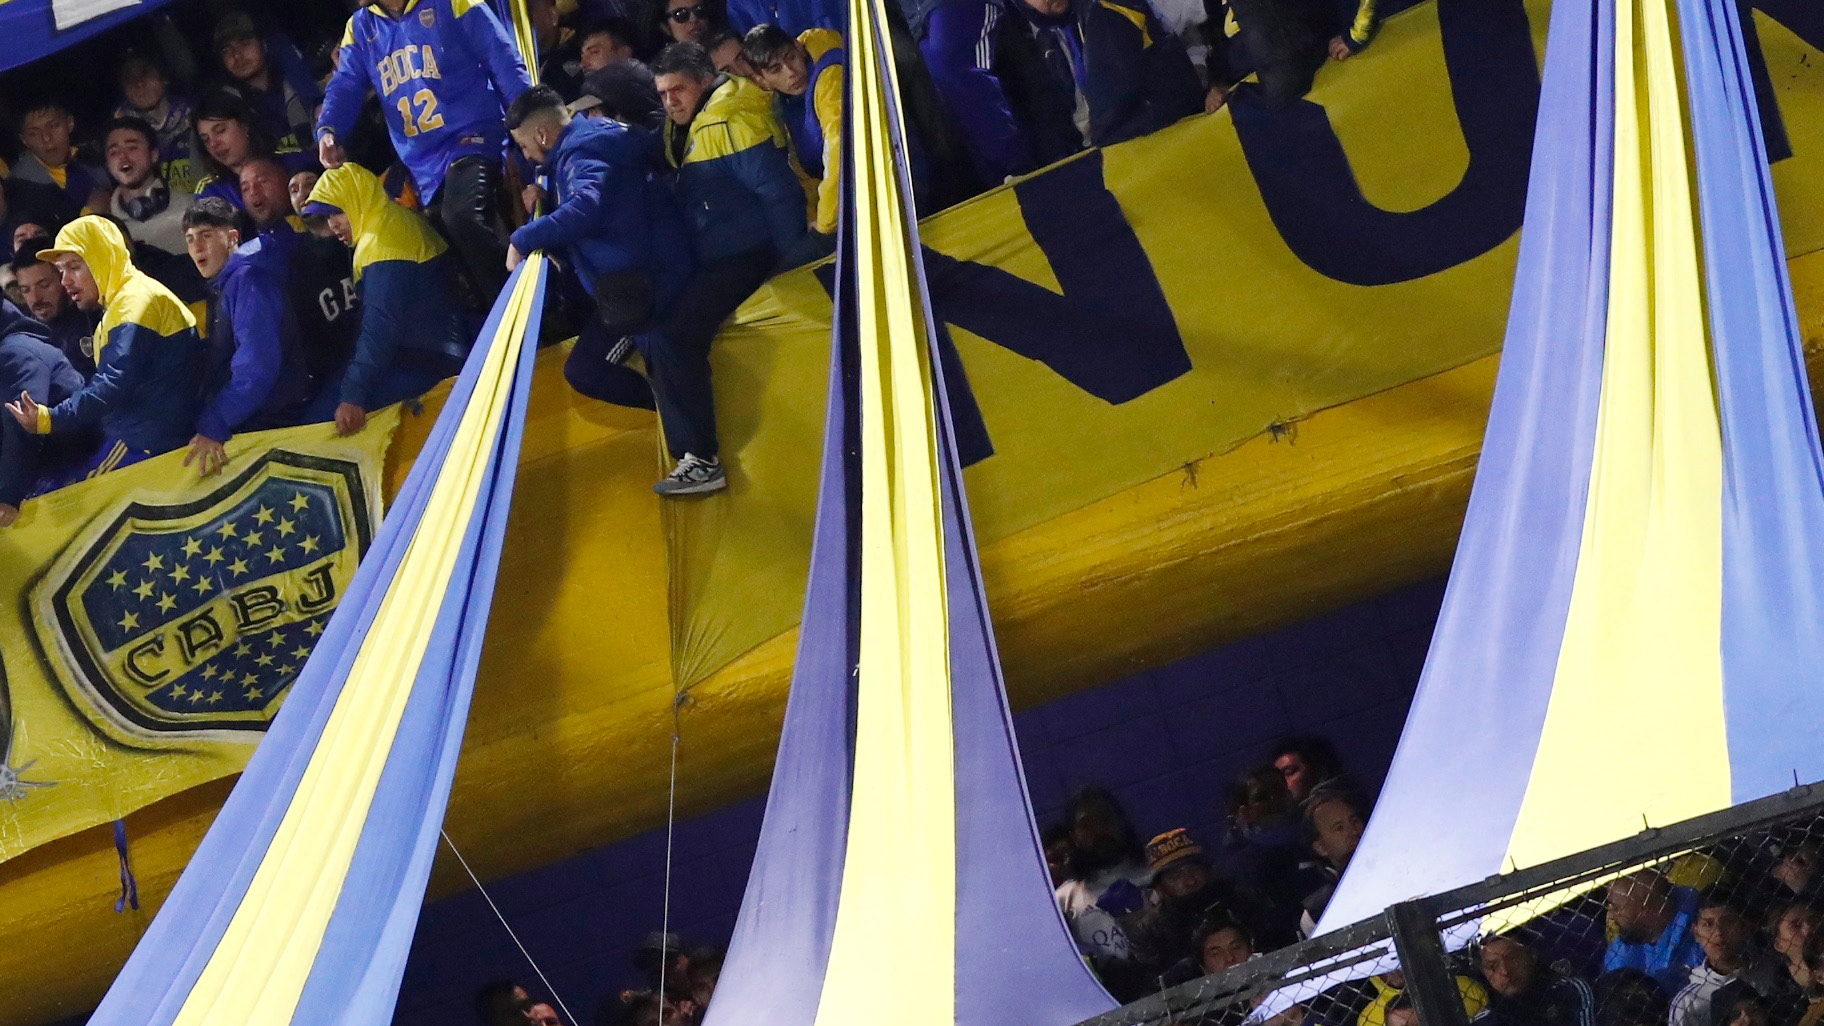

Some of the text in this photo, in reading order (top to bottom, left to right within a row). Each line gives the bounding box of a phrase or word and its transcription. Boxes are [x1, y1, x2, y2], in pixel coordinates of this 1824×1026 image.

[377, 44, 442, 97] BOCA
[396, 88, 445, 137] 12
[126, 562, 335, 686] CABJ
